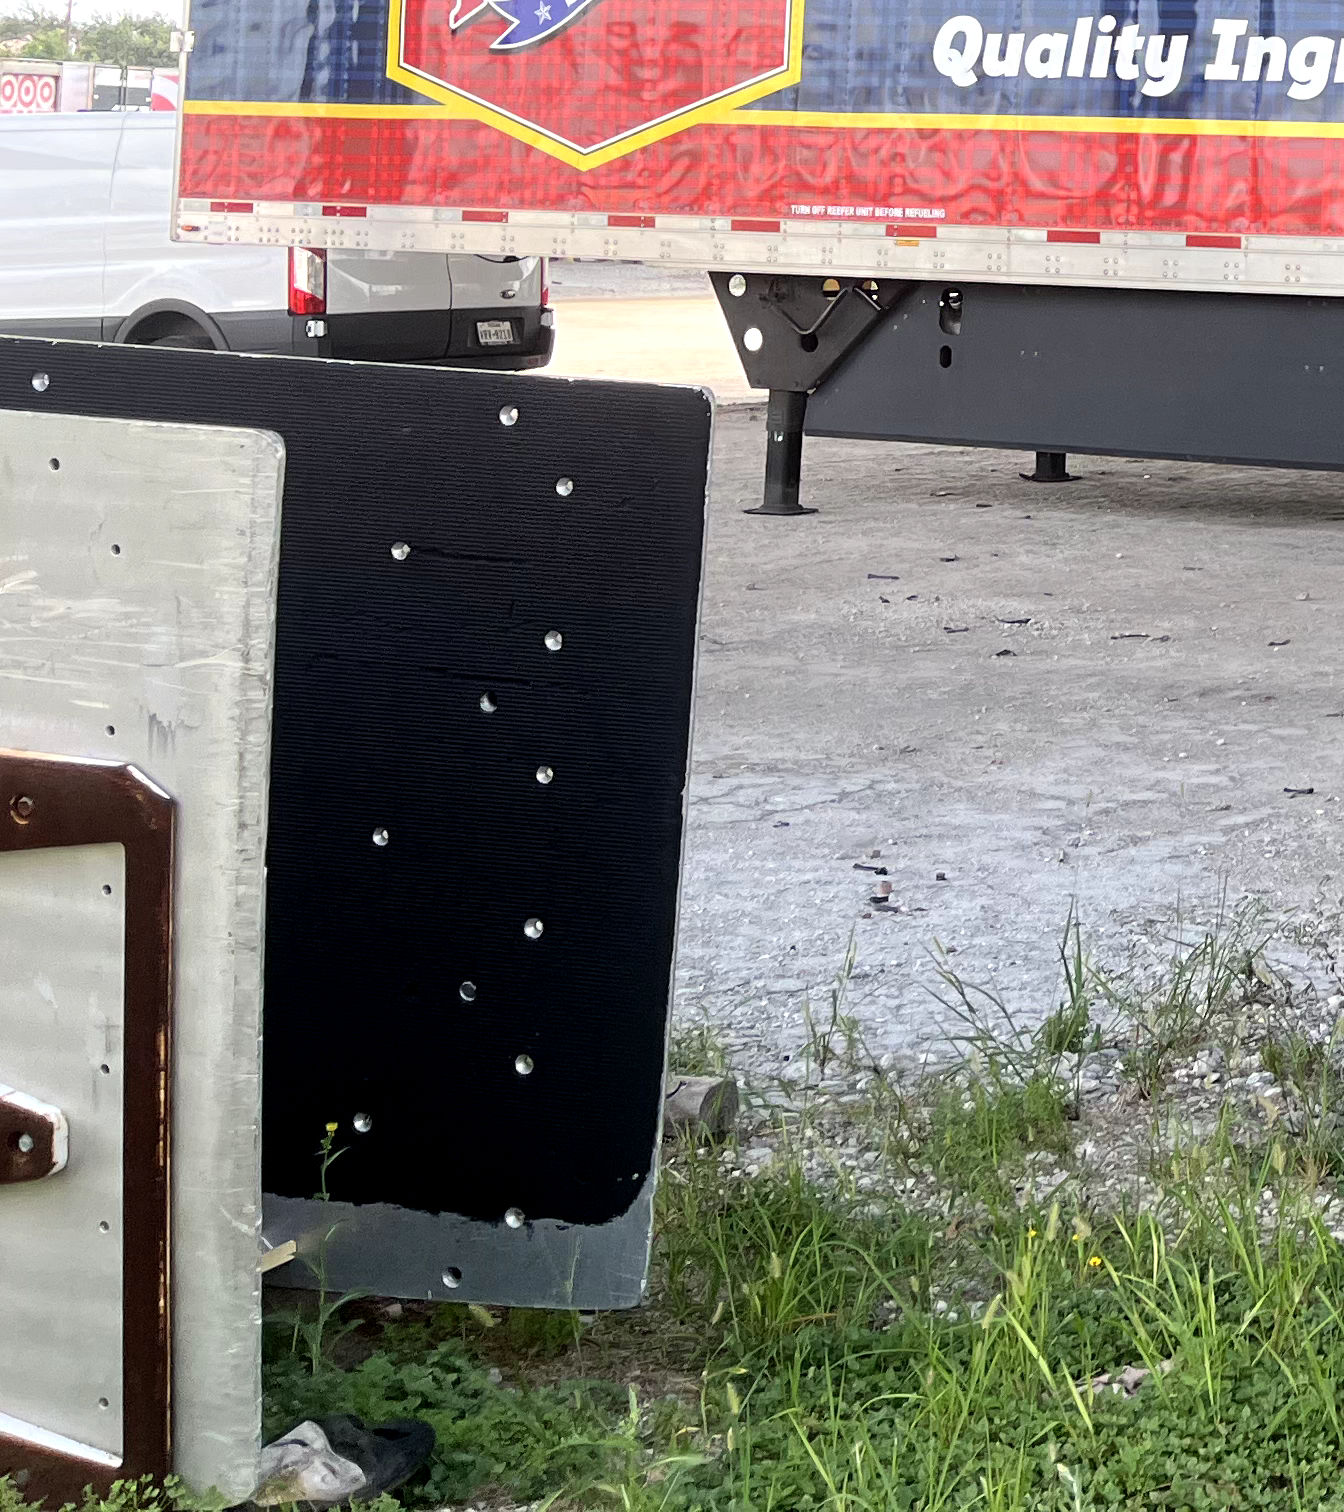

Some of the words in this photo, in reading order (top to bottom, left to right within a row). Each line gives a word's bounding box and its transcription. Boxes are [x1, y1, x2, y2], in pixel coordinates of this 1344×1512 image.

[932, 15, 1190, 98] Quality
[791, 205, 810, 215] TURN
[812, 205, 825, 214] OFF
[827, 205, 854, 216] REEFER
[875, 207, 903, 218] BEFORE
[905, 208, 945, 219] REFUELING
